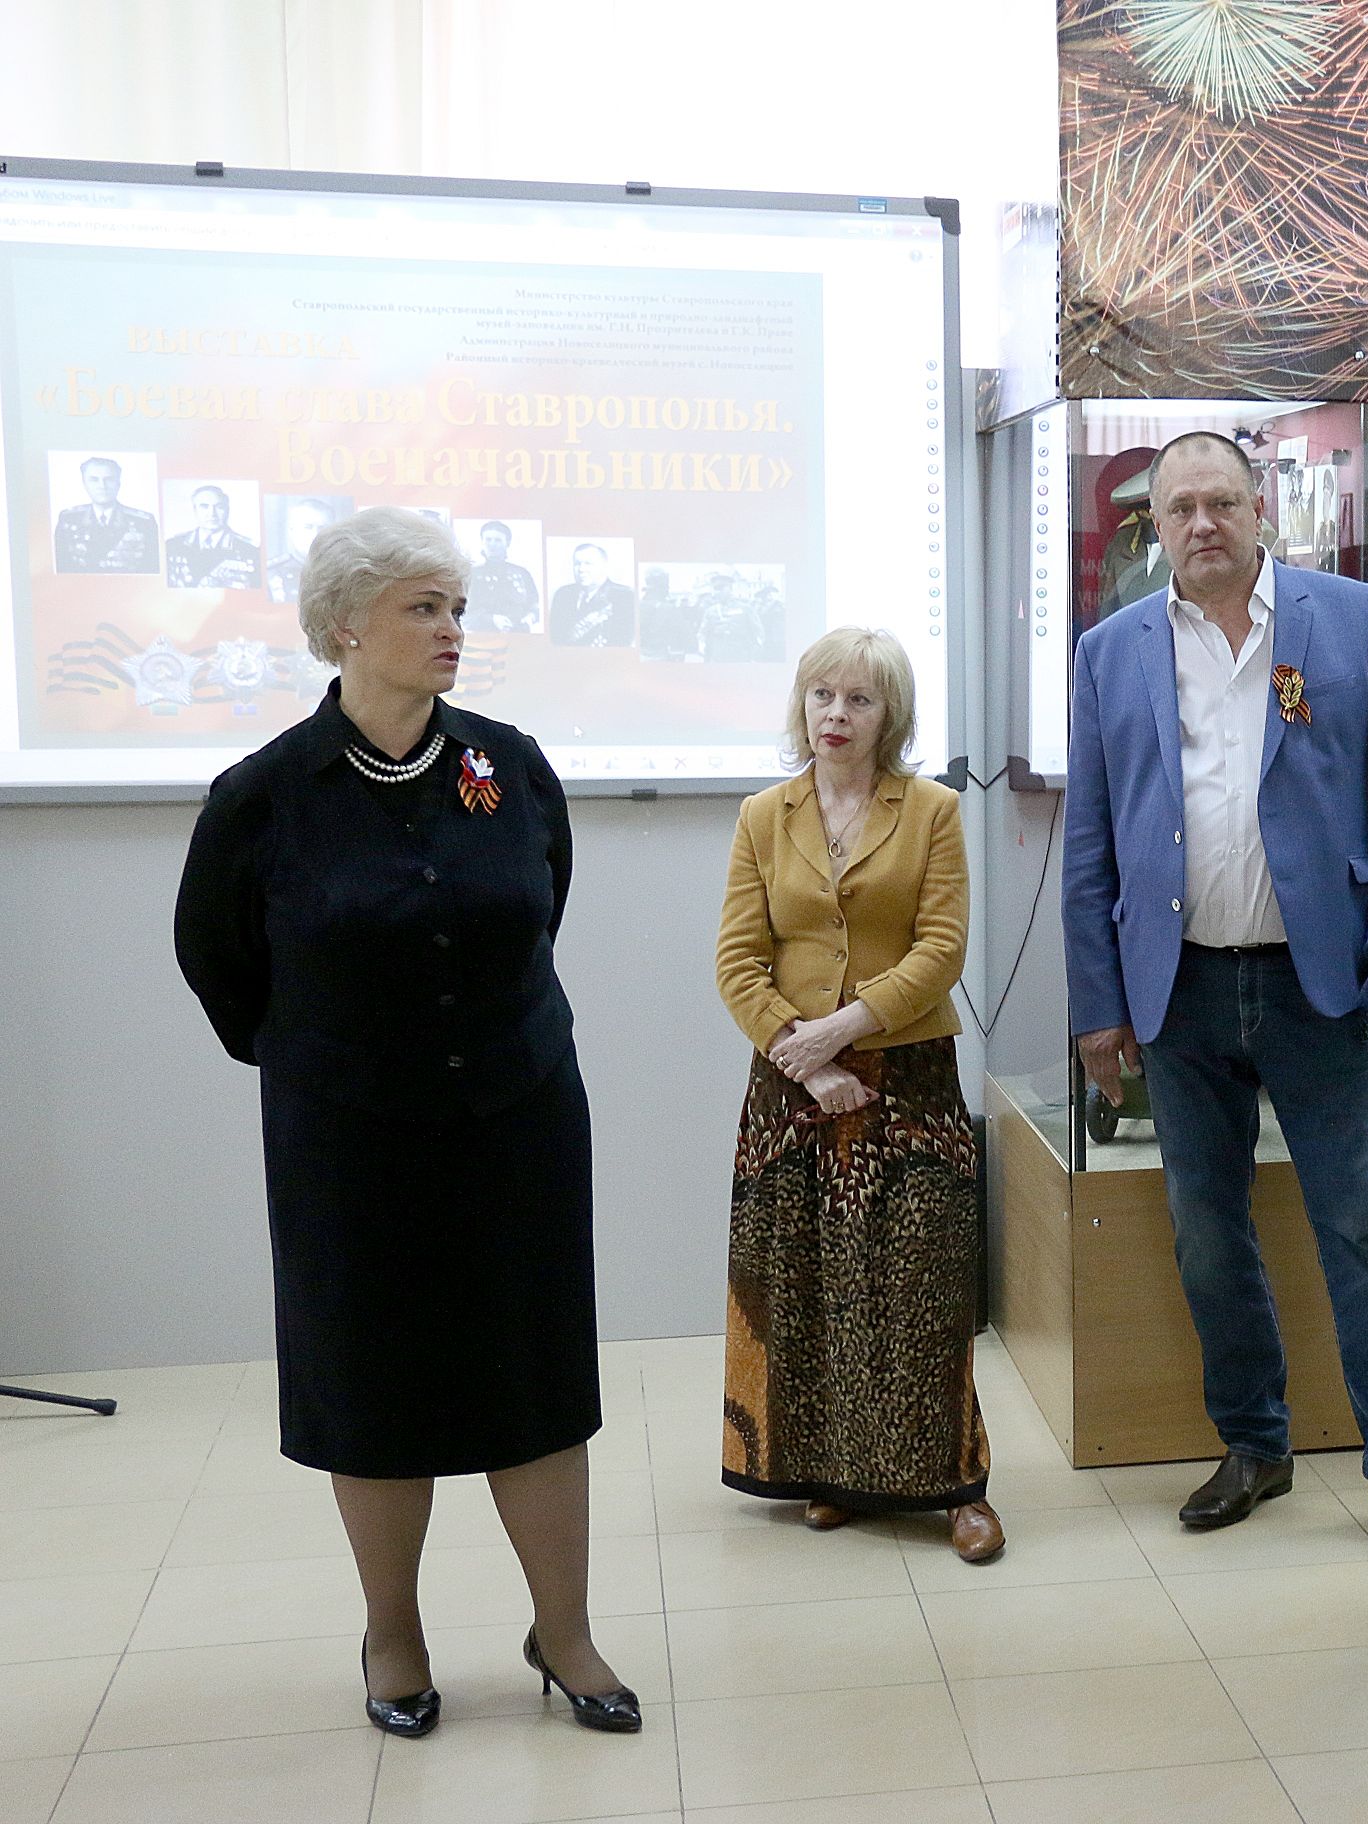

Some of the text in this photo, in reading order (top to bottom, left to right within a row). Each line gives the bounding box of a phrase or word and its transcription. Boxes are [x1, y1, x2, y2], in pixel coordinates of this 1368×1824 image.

[32, 189, 89, 203] Windows
[291, 298, 395, 313] Ставропольский
[397, 303, 504, 317] государственный
[514, 288, 601, 304] Министерство
[604, 293, 660, 305] культуры
[662, 293, 765, 308] Ставропольского
[126, 325, 360, 360] ВЫСТАВКА
[459, 334, 556, 350] Администрация
[446, 351, 509, 364] Районный
[34, 366, 794, 444] «Боевая слава Ставрополья.
[272, 424, 794, 493] Военачальники»
